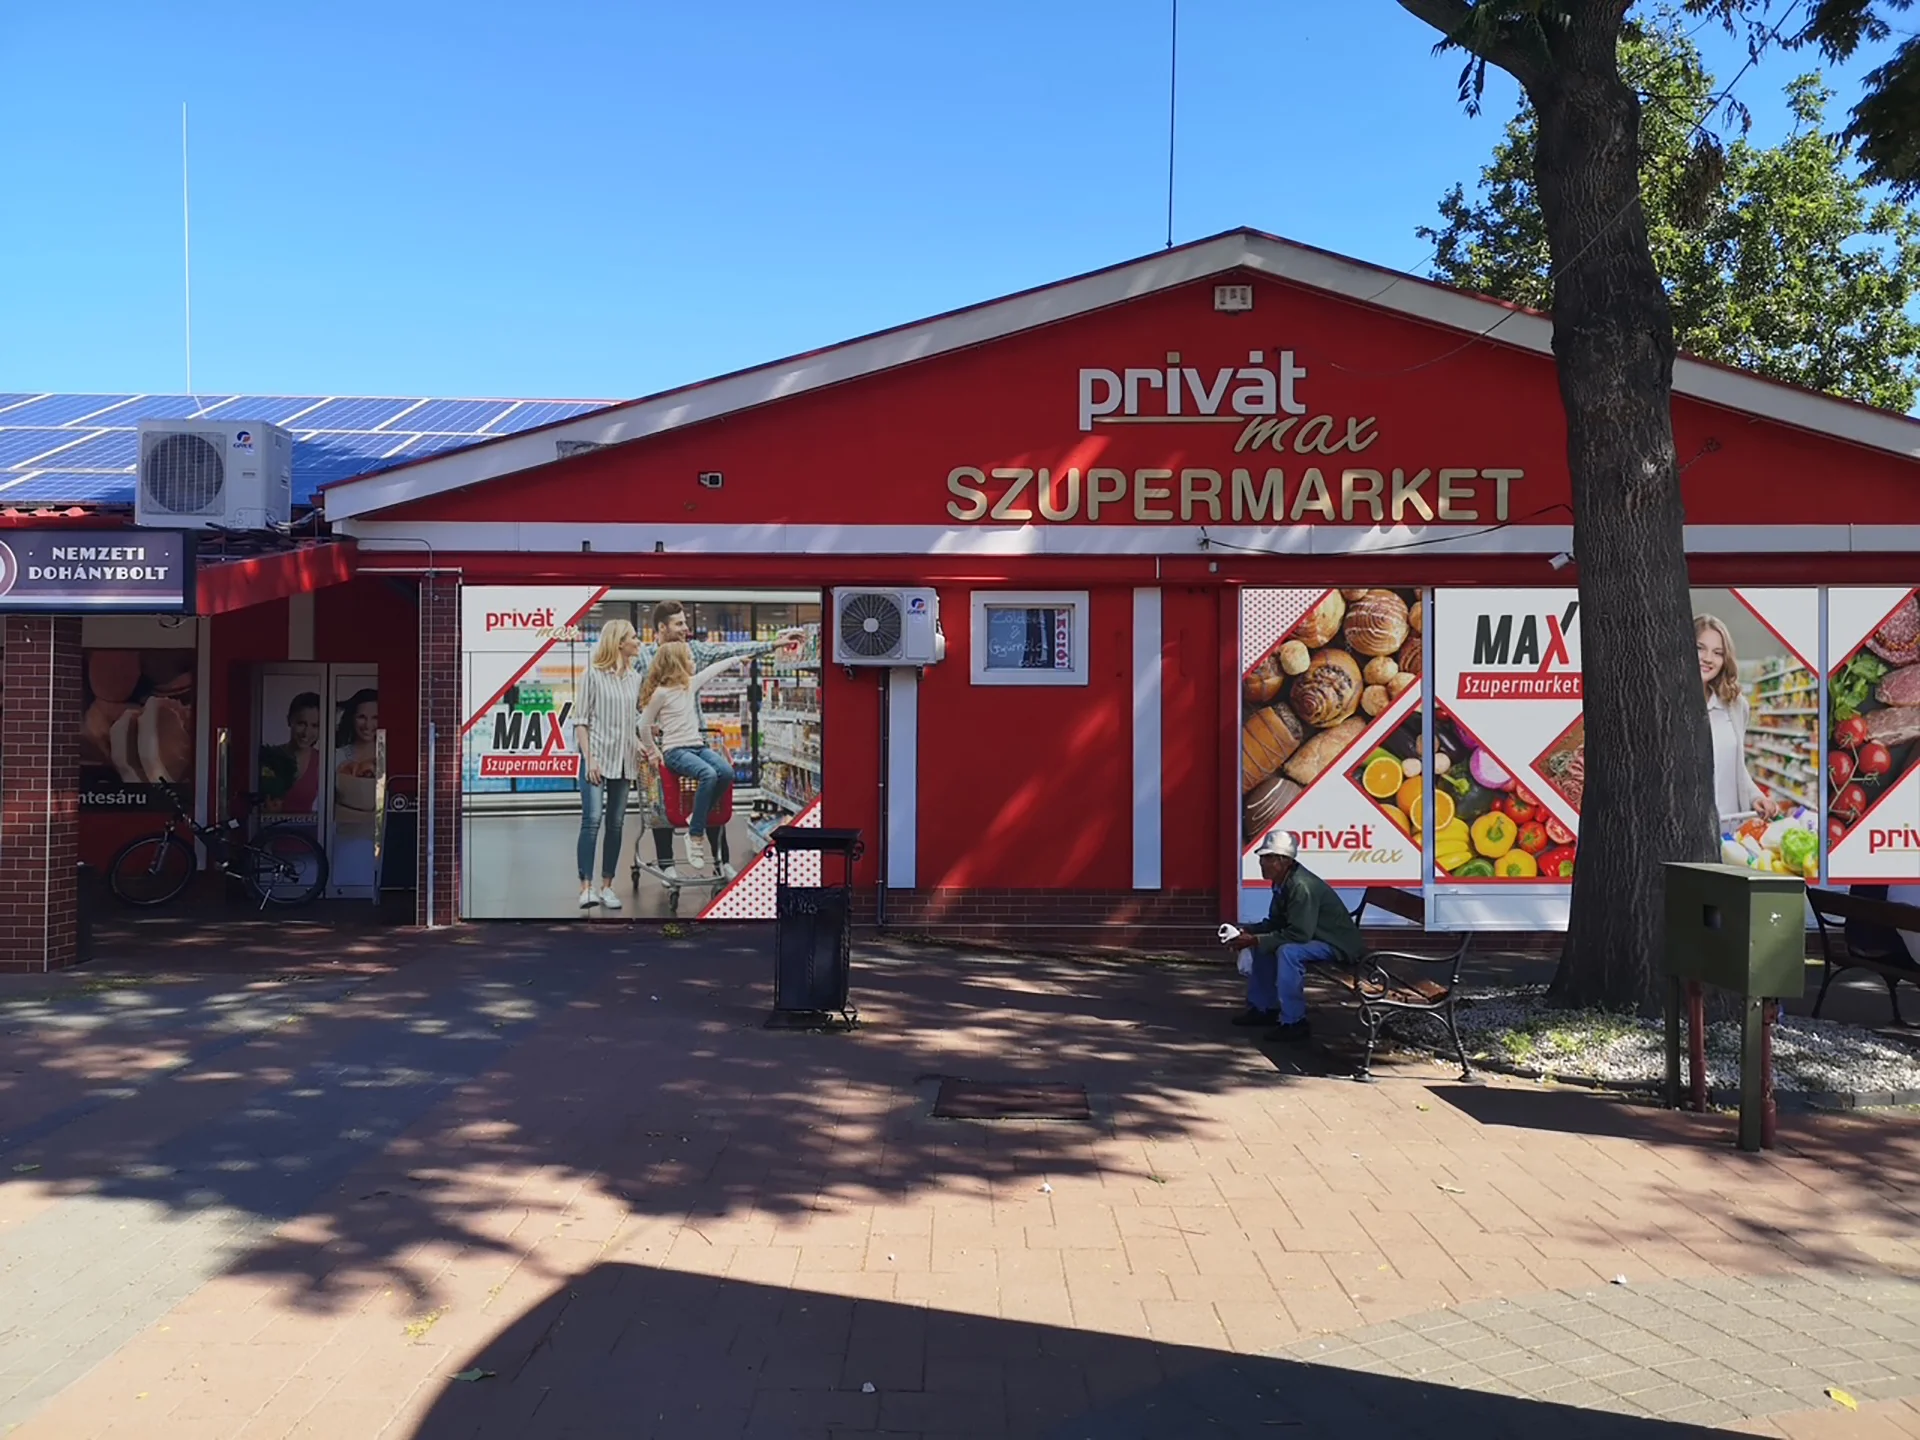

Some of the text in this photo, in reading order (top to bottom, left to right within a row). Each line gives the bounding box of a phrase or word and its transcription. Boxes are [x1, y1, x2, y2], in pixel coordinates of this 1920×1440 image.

[1078, 350, 1307, 432] privát
[1233, 414, 1380, 455] max
[946, 466, 1525, 522] SZUPERMARKET
[52, 547, 145, 561] NEMZETI
[28, 563, 169, 580] DOHÁNYBOLT
[486, 607, 555, 632] privát
[535, 626, 579, 639] max
[1473, 601, 1579, 673] MAX
[1464, 675, 1580, 698] Szupermarket
[492, 702, 573, 757] MAX
[486, 758, 573, 775] Szupermarket
[1347, 848, 1404, 864] max
